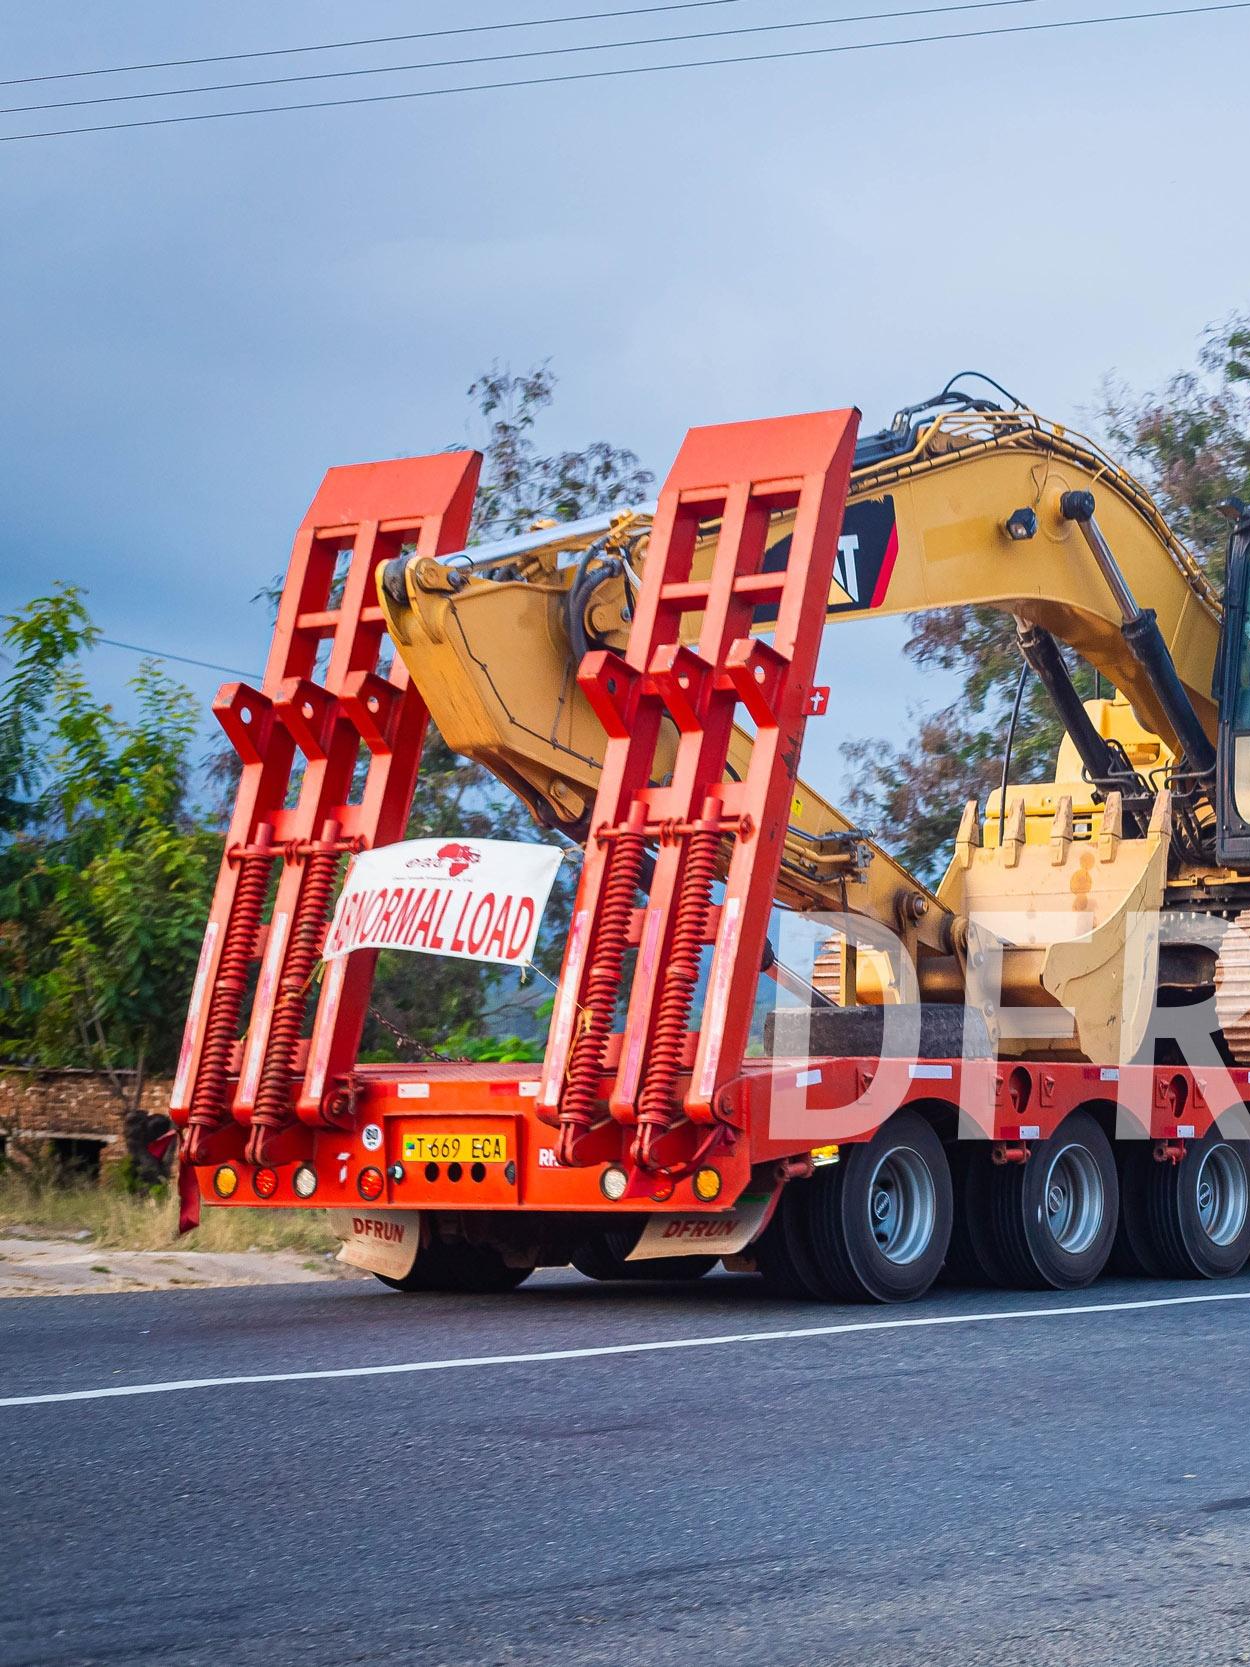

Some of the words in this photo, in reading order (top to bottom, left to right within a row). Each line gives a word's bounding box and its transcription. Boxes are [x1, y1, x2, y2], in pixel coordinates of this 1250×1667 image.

[450, 891, 535, 960] LOAD
[416, 1138, 425, 1158] T
[430, 1138, 460, 1158] 669
[472, 1138, 502, 1158] ECA
[352, 1217, 405, 1243] DFRUN
[662, 1219, 738, 1239] DFRUN
